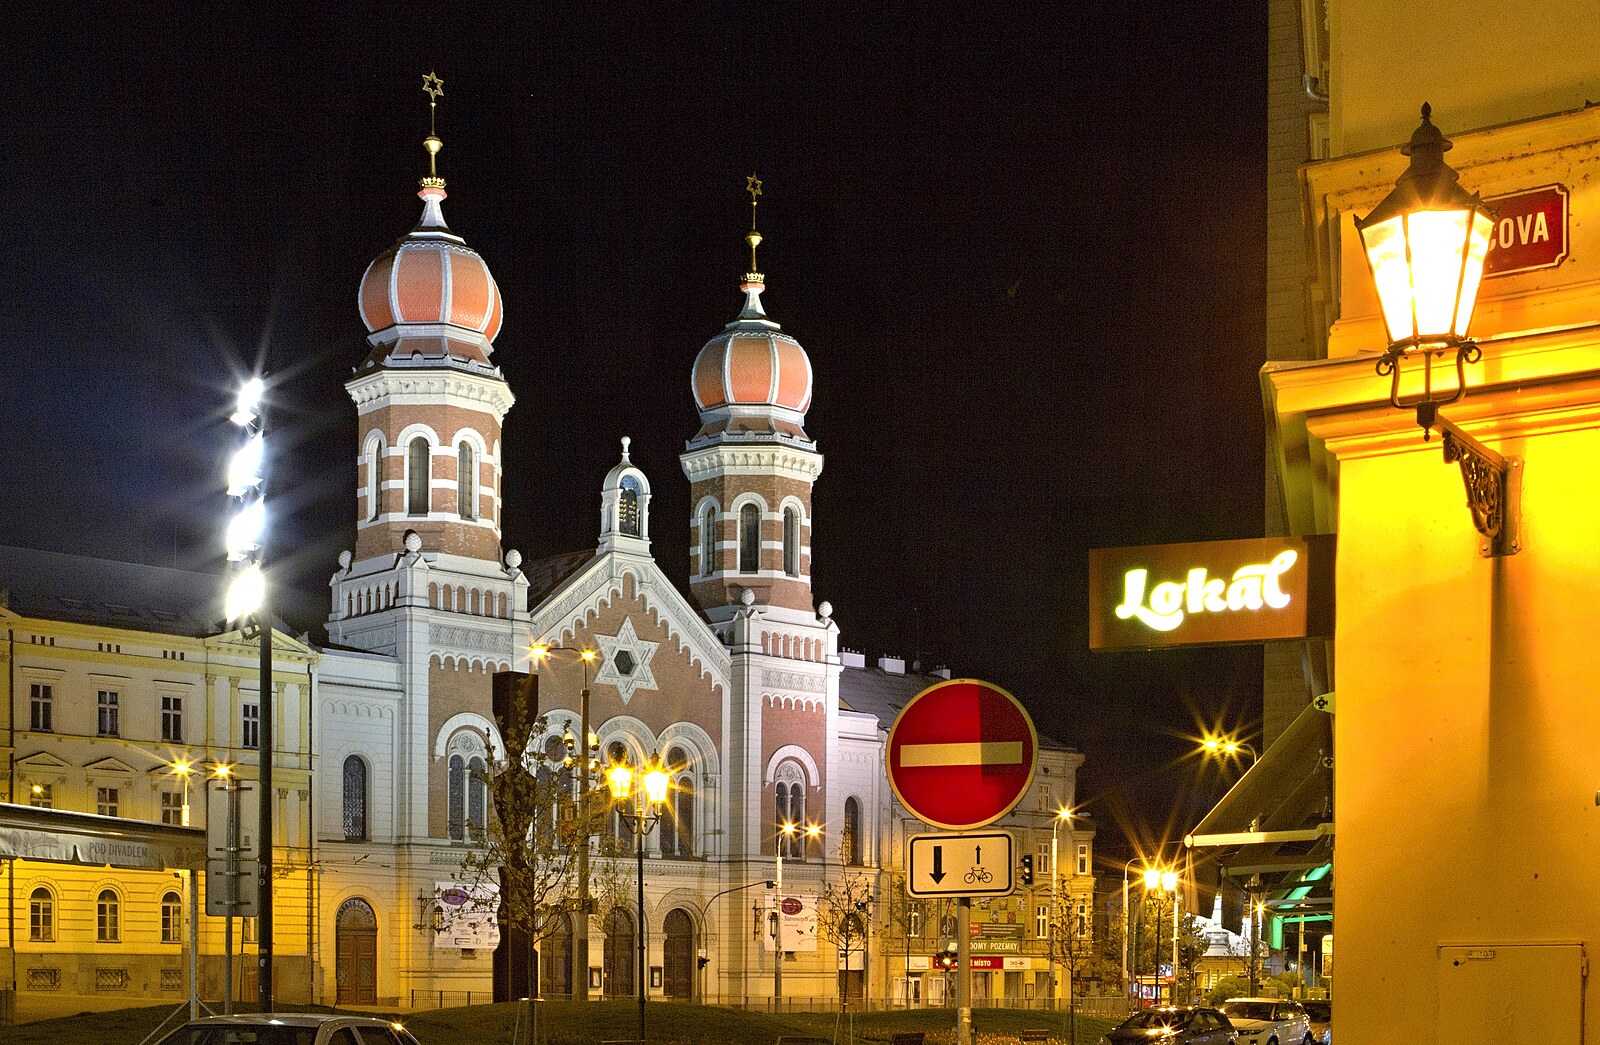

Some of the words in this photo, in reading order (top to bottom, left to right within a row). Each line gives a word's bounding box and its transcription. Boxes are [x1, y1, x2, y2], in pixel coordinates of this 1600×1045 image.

[89, 841, 107, 855] POD
[108, 843, 148, 858] DIVADLEM
[990, 942, 1017, 951] POZEMKY
